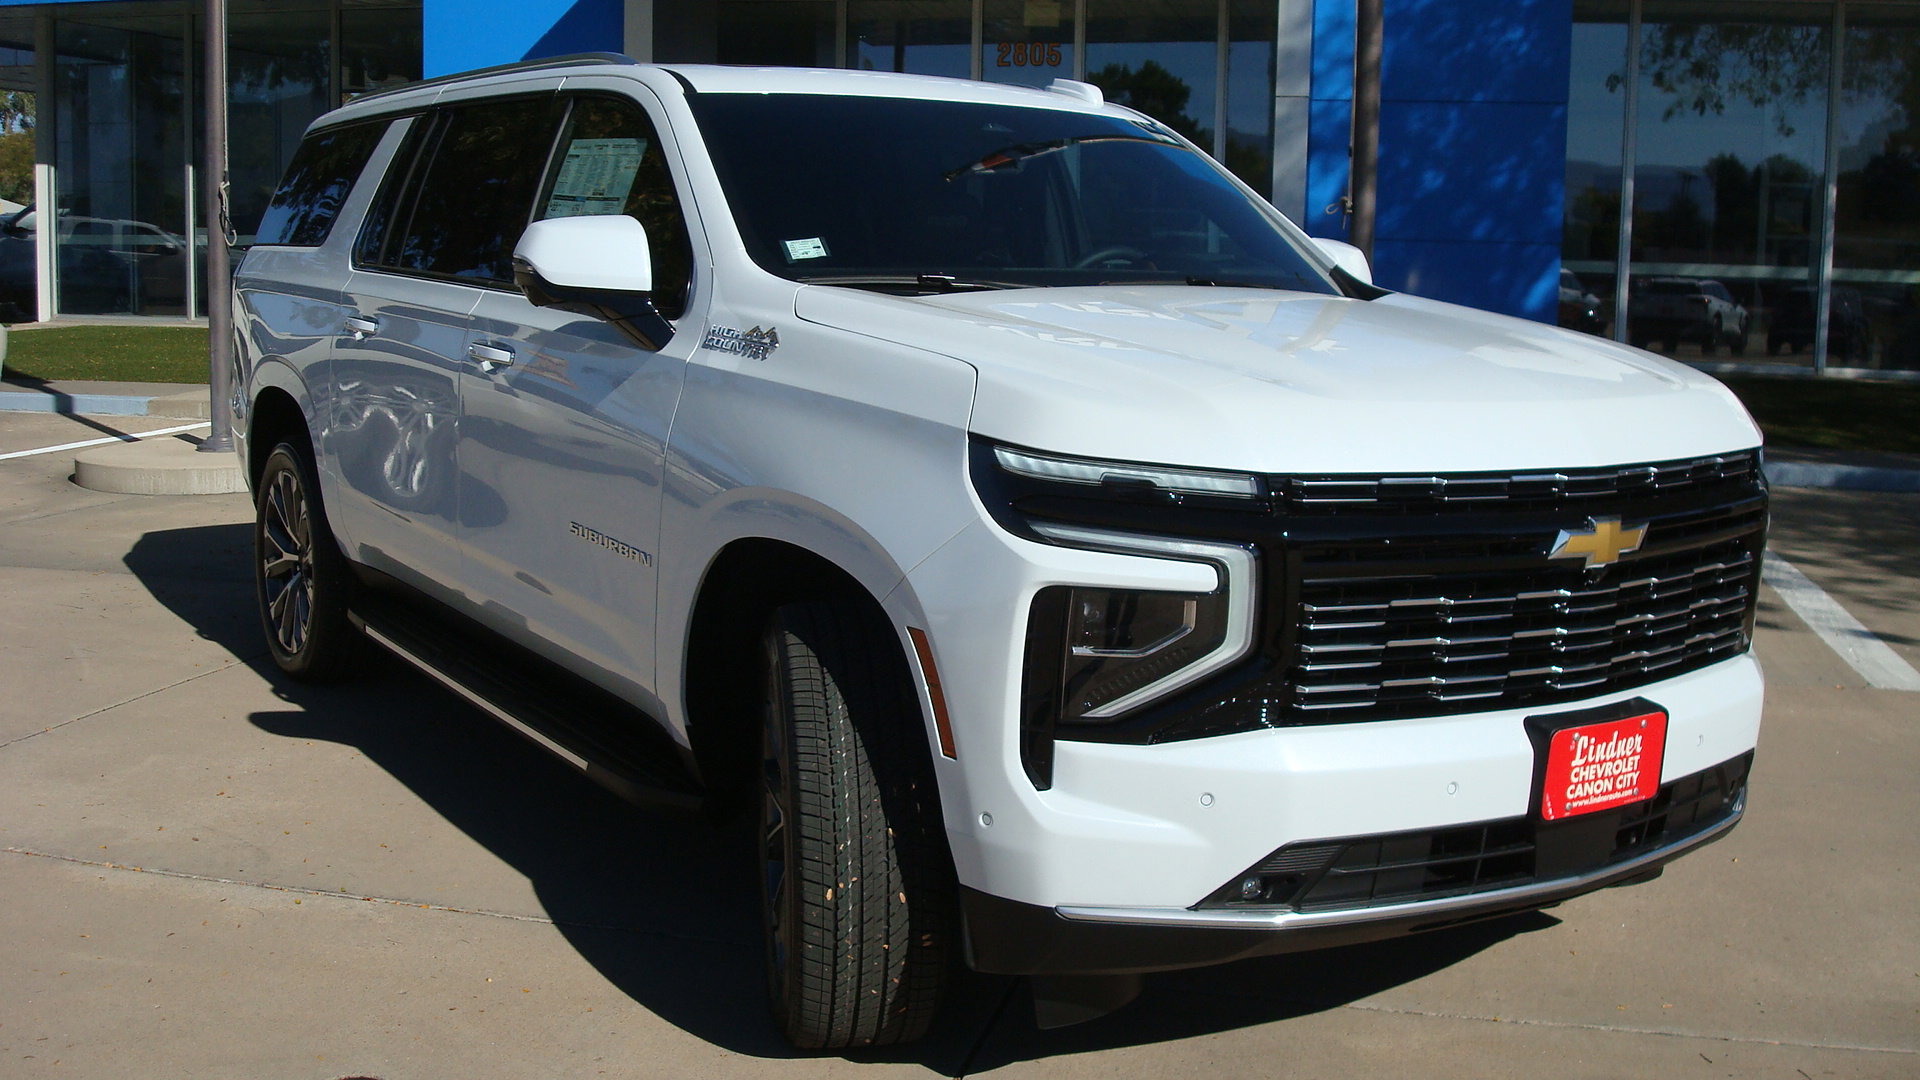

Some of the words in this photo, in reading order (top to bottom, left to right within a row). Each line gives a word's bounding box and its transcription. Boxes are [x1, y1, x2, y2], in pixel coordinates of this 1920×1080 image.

[997, 41, 1061, 67] 2805
[709, 323, 744, 339] HIGH
[702, 336, 773, 361] COUNTRY
[569, 521, 652, 567] SUBURBAN
[1571, 731, 1642, 766] Lindner
[1570, 755, 1640, 783] CHEVROLET
[1566, 779, 1614, 799] CANON
[1615, 771, 1639, 789] CITY
